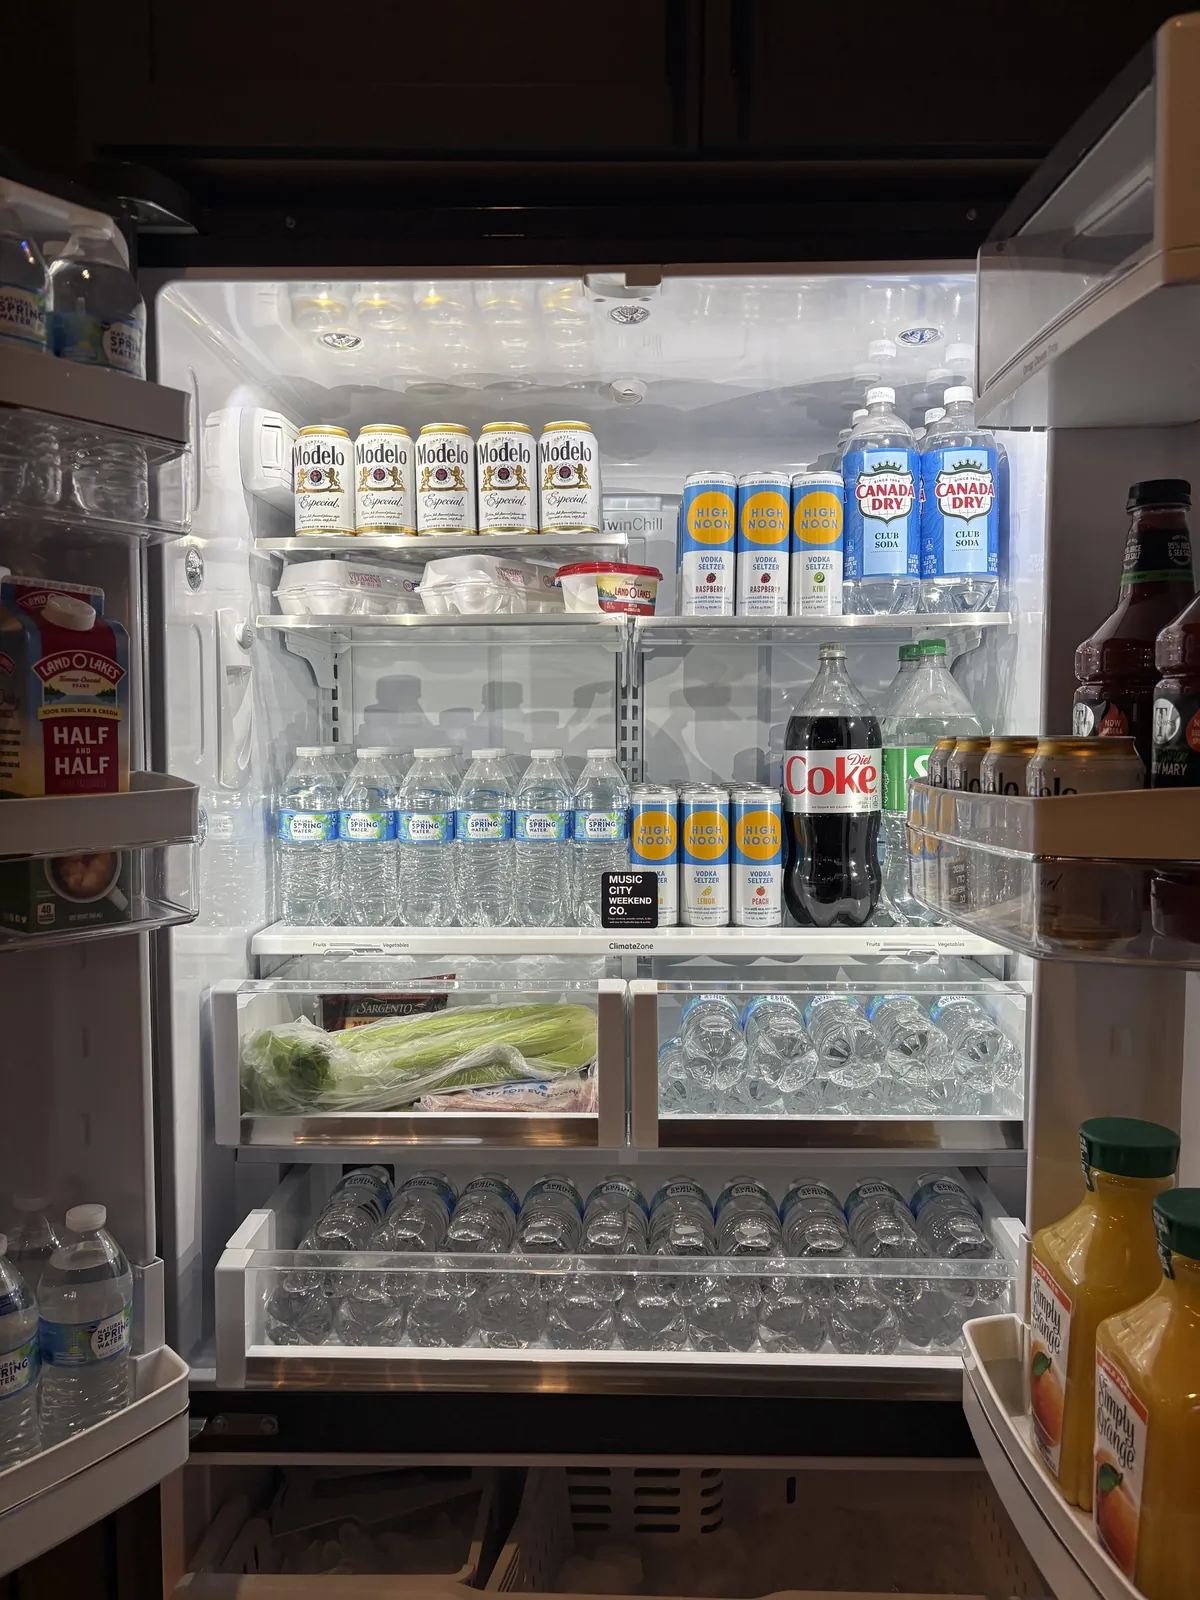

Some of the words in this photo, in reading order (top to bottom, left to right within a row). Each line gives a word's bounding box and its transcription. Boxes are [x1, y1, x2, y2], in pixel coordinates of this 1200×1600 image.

[294, 445, 344, 466] Modelo
[356, 443, 407, 465] Modelo
[417, 443, 468, 465] Modelo
[479, 441, 530, 465] Modelo
[541, 440, 592, 464] Modelo
[856, 484, 915, 499] CANADA
[935, 483, 995, 498] CANADA
[871, 498, 902, 511] DRY
[952, 497, 983, 509] DRY
[696, 508, 728, 517] HIGH
[751, 508, 782, 517] HIGH
[804, 508, 836, 517] HIGH
[603, 517, 663, 531] TwinChill
[694, 519, 730, 529] NOON
[749, 519, 784, 529] NOON
[801, 519, 838, 529] NOON
[875, 540, 899, 548] SODA
[955, 539, 979, 547] SODA
[615, 587, 629, 596] LAND
[629, 587, 637, 599] O
[637, 590, 651, 598] LAKES
[40, 657, 70, 677] LAND
[72, 653, 87, 668] O
[89, 657, 121, 679] LAKES
[1104, 719, 1121, 727] NOW
[53, 726, 109, 745] HALF
[55, 756, 110, 775] HALF
[847, 753, 872, 766] Diet
[1162, 763, 1188, 775] MARY
[785, 756, 877, 796] Coke
[640, 826, 670, 834] HIGH
[691, 826, 722, 834] HIGH
[745, 826, 776, 834] HIGH
[637, 836, 672, 845] NOON
[689, 836, 724, 845] NOON
[743, 836, 778, 845] NOON
[609, 875, 643, 884] MUSIC
[609, 886, 633, 895] CITY
[608, 897, 652, 905] WEEKEND
[41, 904, 51, 914] 40
[609, 906, 628, 915] CO.
[608, 942, 654, 950] ClimateZone
[356, 1000, 413, 1014] SARGENTO
[1033, 1276, 1061, 1335] Simply
[97, 1320, 123, 1335] NATURAL
[97, 1318, 130, 1344] SPRING
[0, 1359, 17, 1370] URAL
[0, 1358, 29, 1378] RING
[1098, 1374, 1135, 1448] Simply
[1097, 1406, 1136, 1470] Orange
